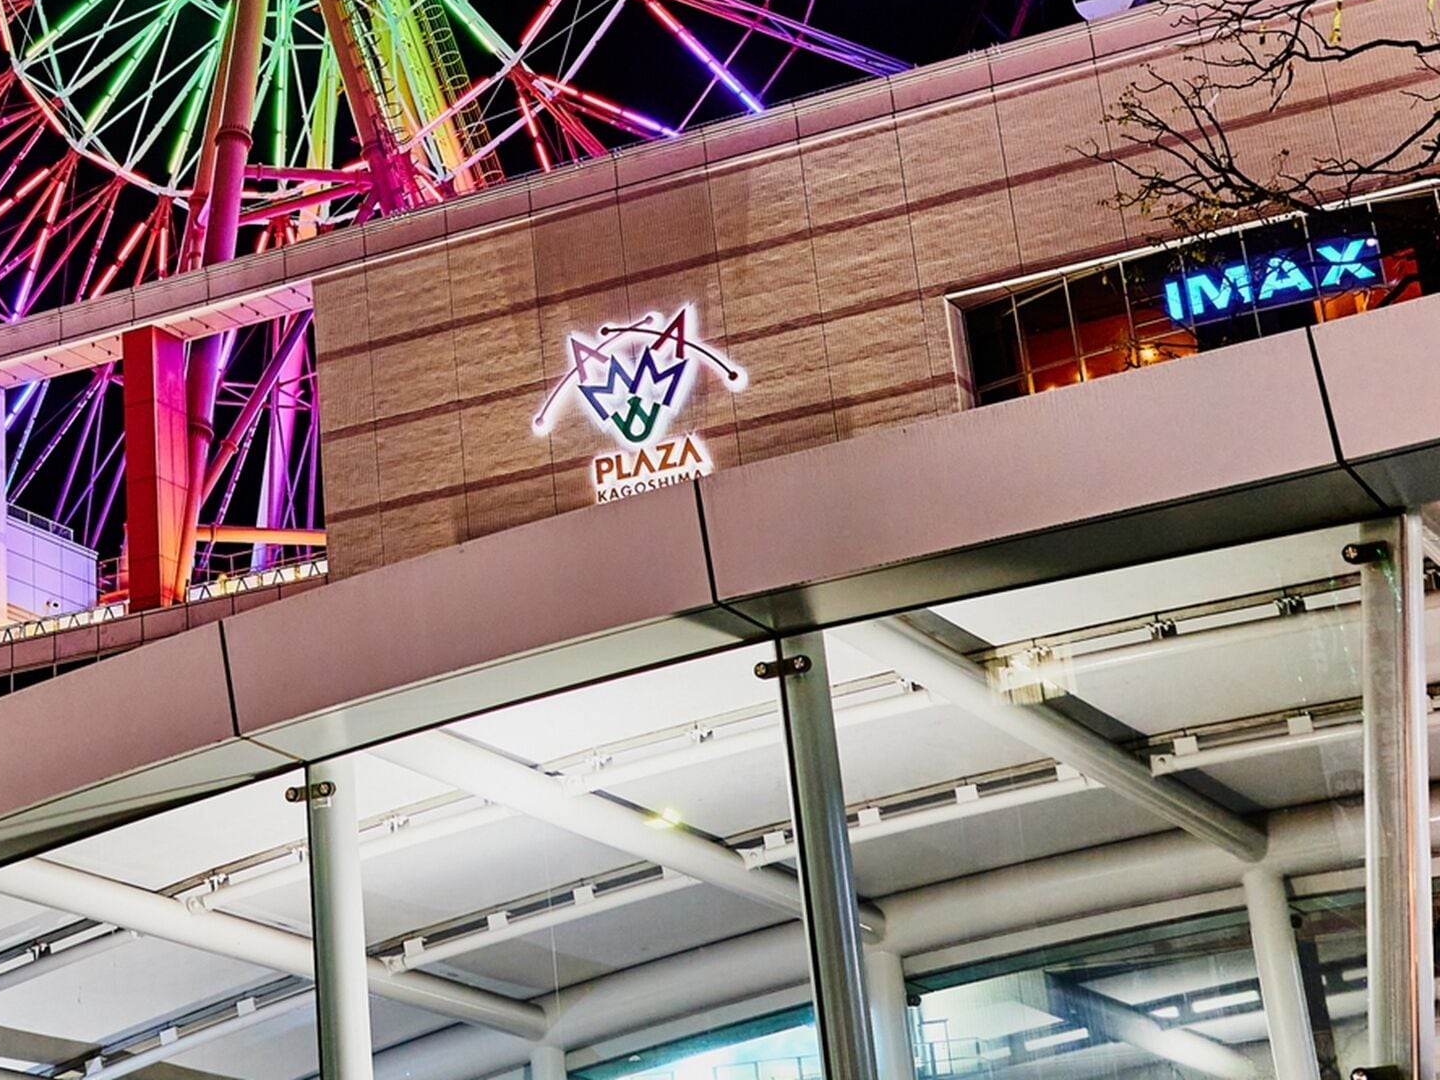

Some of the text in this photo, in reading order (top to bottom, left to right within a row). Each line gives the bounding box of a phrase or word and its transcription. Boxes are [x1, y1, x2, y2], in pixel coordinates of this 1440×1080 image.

[1164, 238, 1376, 320] IMAX
[595, 437, 703, 484] PLAZA
[597, 469, 705, 502] KAGOSHIMA
